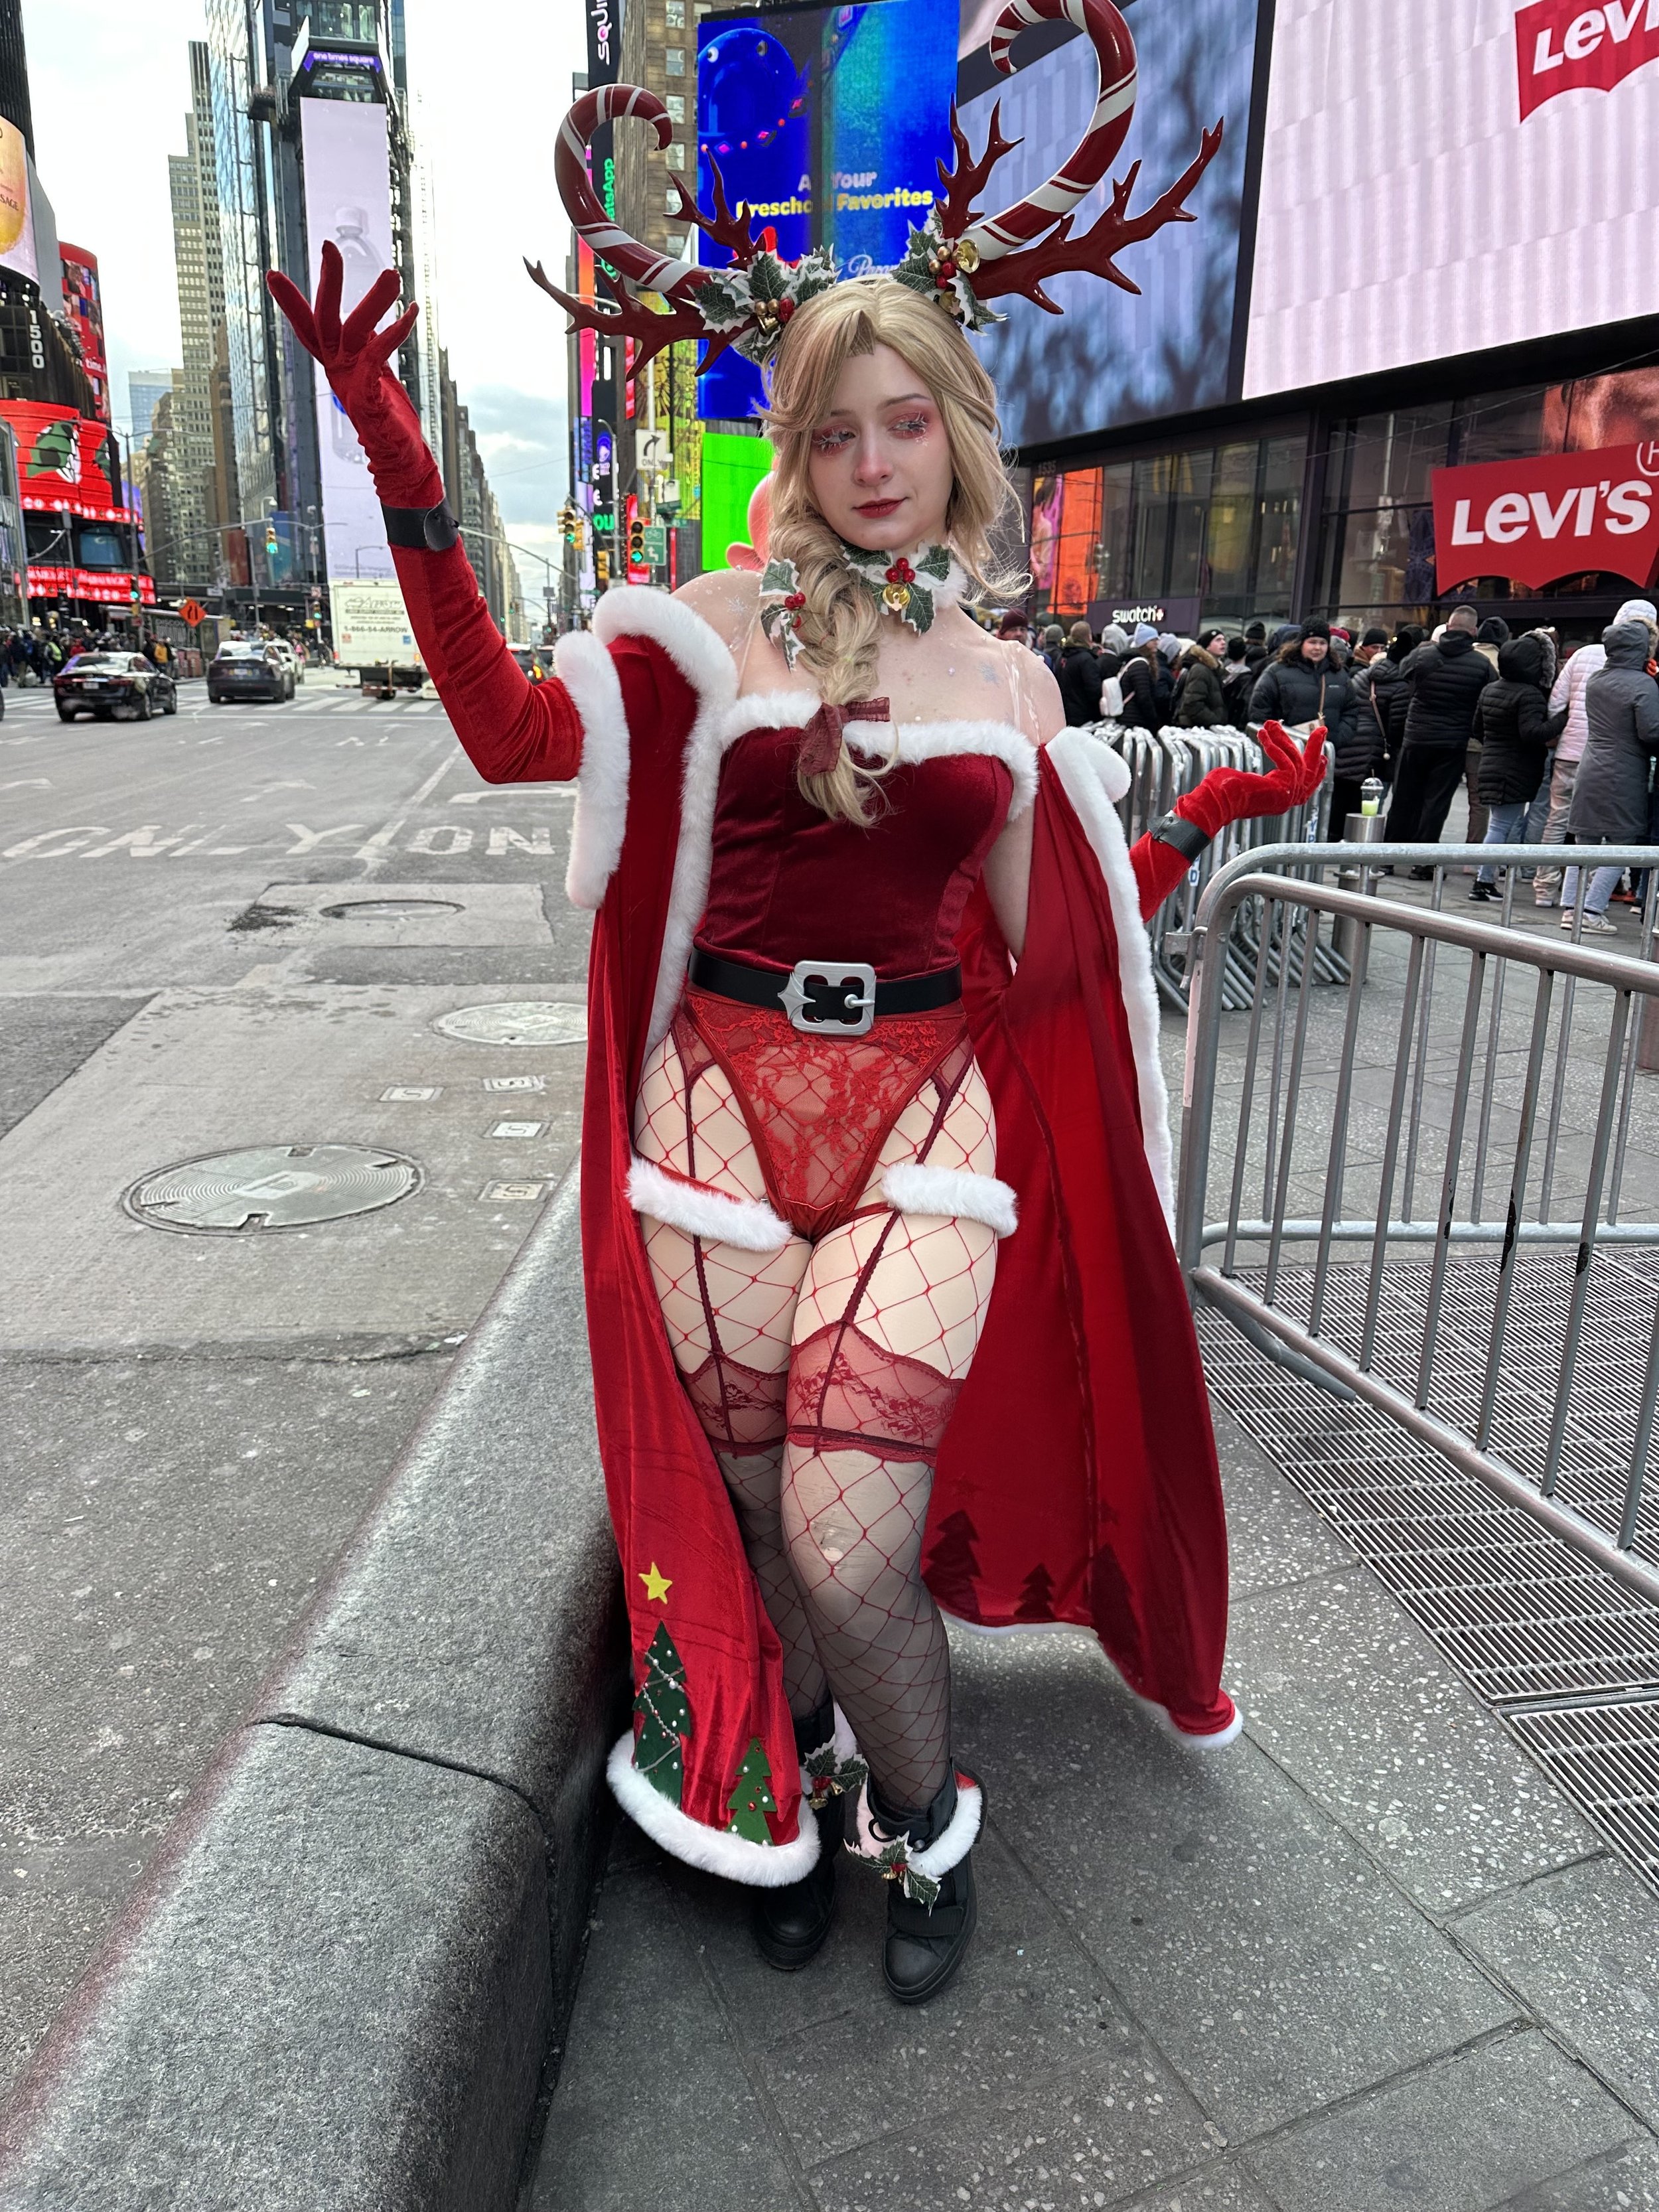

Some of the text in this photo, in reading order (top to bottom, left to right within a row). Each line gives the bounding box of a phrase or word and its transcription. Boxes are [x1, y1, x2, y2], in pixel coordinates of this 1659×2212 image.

[603, 157, 615, 221] atsApp
[837, 186, 933, 211] Favorites
[29, 309, 44, 369] 1500
